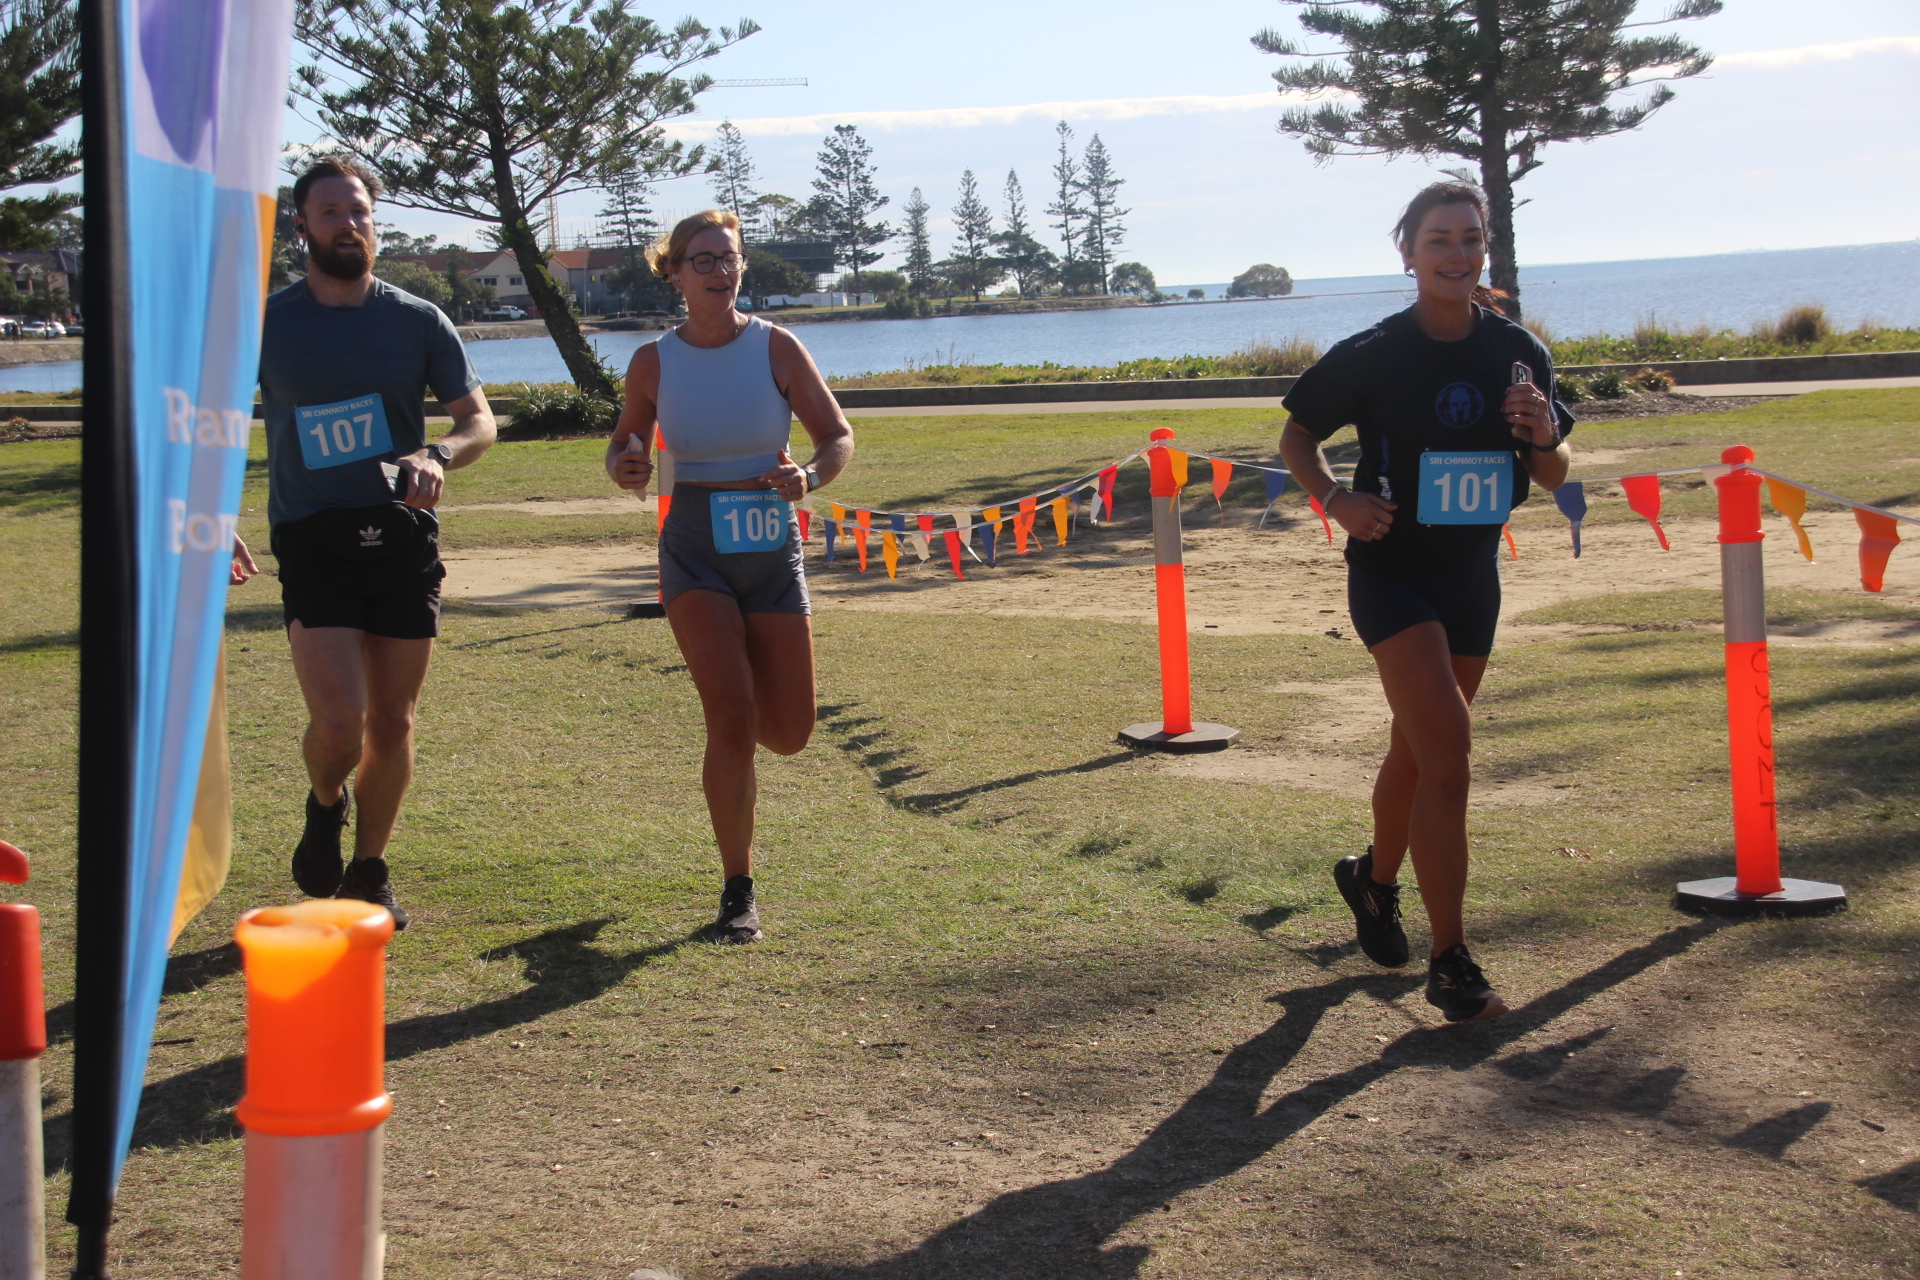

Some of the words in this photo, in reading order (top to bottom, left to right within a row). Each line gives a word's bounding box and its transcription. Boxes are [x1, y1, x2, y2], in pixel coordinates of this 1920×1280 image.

[302, 411, 313, 419] SRI
[314, 405, 349, 417] CHINMOY
[350, 399, 374, 410] RACES
[310, 412, 373, 457] 107
[1429, 457, 1442, 465] SRI
[1444, 457, 1482, 465] CHINMOY
[1484, 456, 1505, 464] RACES
[731, 494, 763, 502] CHINMOY
[1433, 472, 1498, 512] 101
[724, 507, 780, 542] 106
